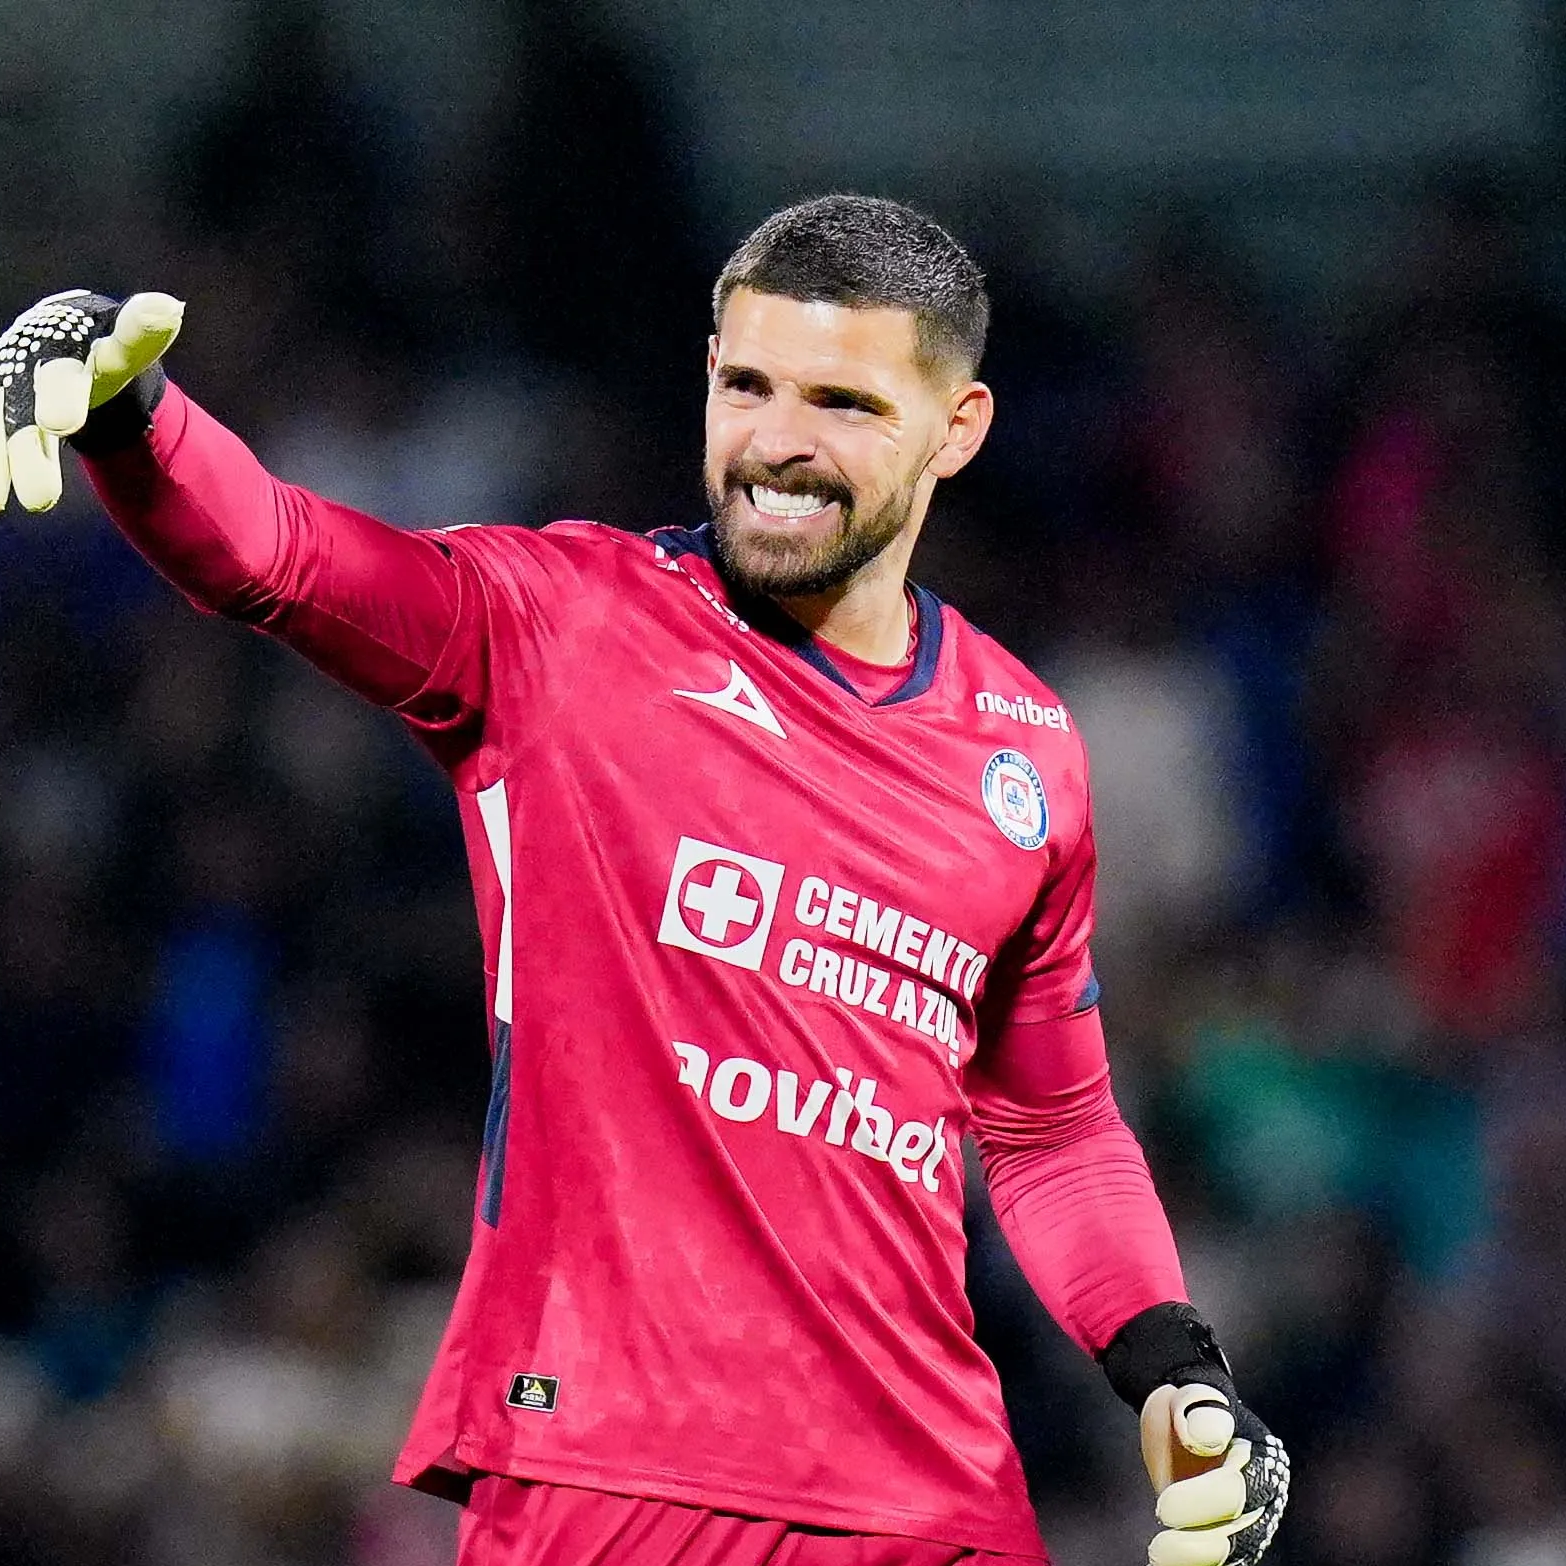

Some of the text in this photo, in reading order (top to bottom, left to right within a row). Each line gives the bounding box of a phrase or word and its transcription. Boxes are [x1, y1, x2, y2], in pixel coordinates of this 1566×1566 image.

[975, 691, 1070, 733] novibet
[779, 937, 891, 1017] CRUZ
[795, 875, 988, 1001] CEMENTO
